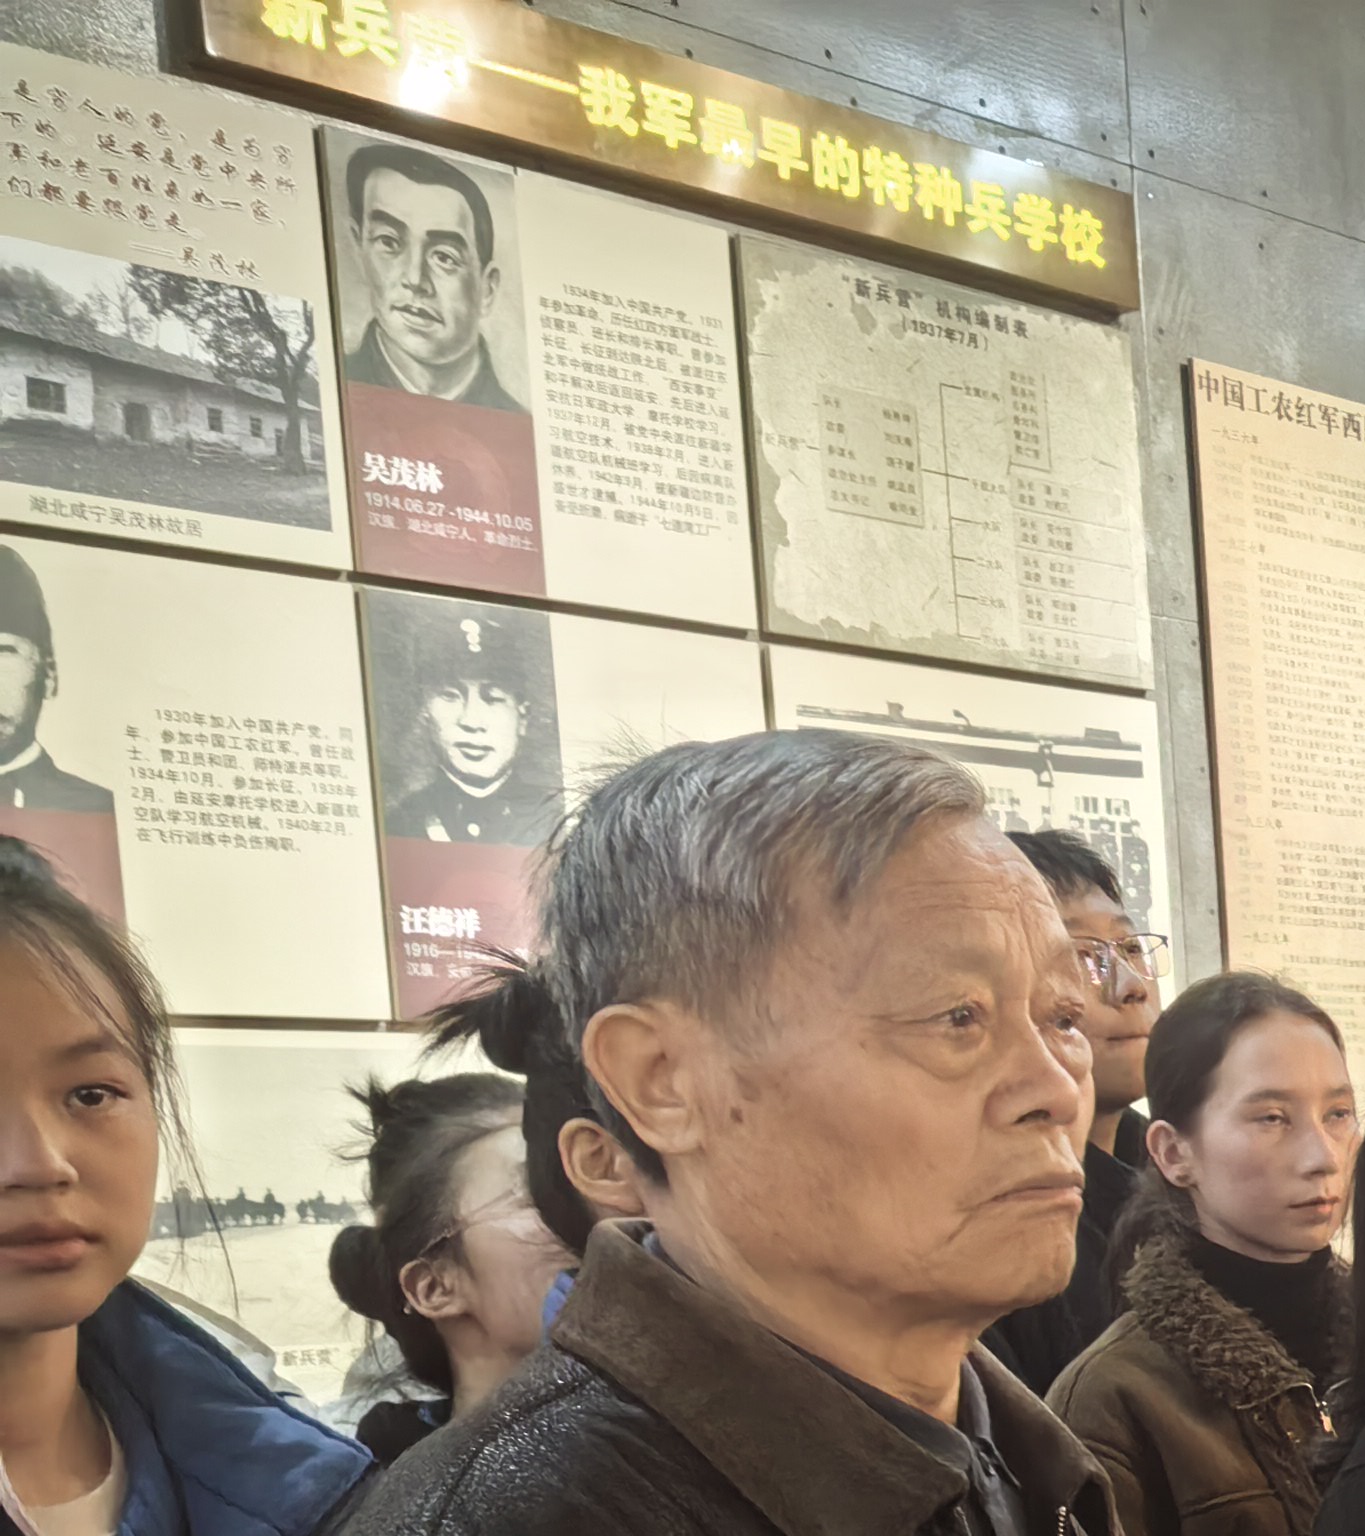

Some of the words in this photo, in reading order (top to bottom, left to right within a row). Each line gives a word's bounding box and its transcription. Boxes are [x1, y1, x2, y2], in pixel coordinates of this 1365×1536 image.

[362, 452, 444, 494] 吴茂林
[30, 495, 203, 538] 湖北咸宁吴茂林故居
[399, 903, 482, 940] 汪德祥
